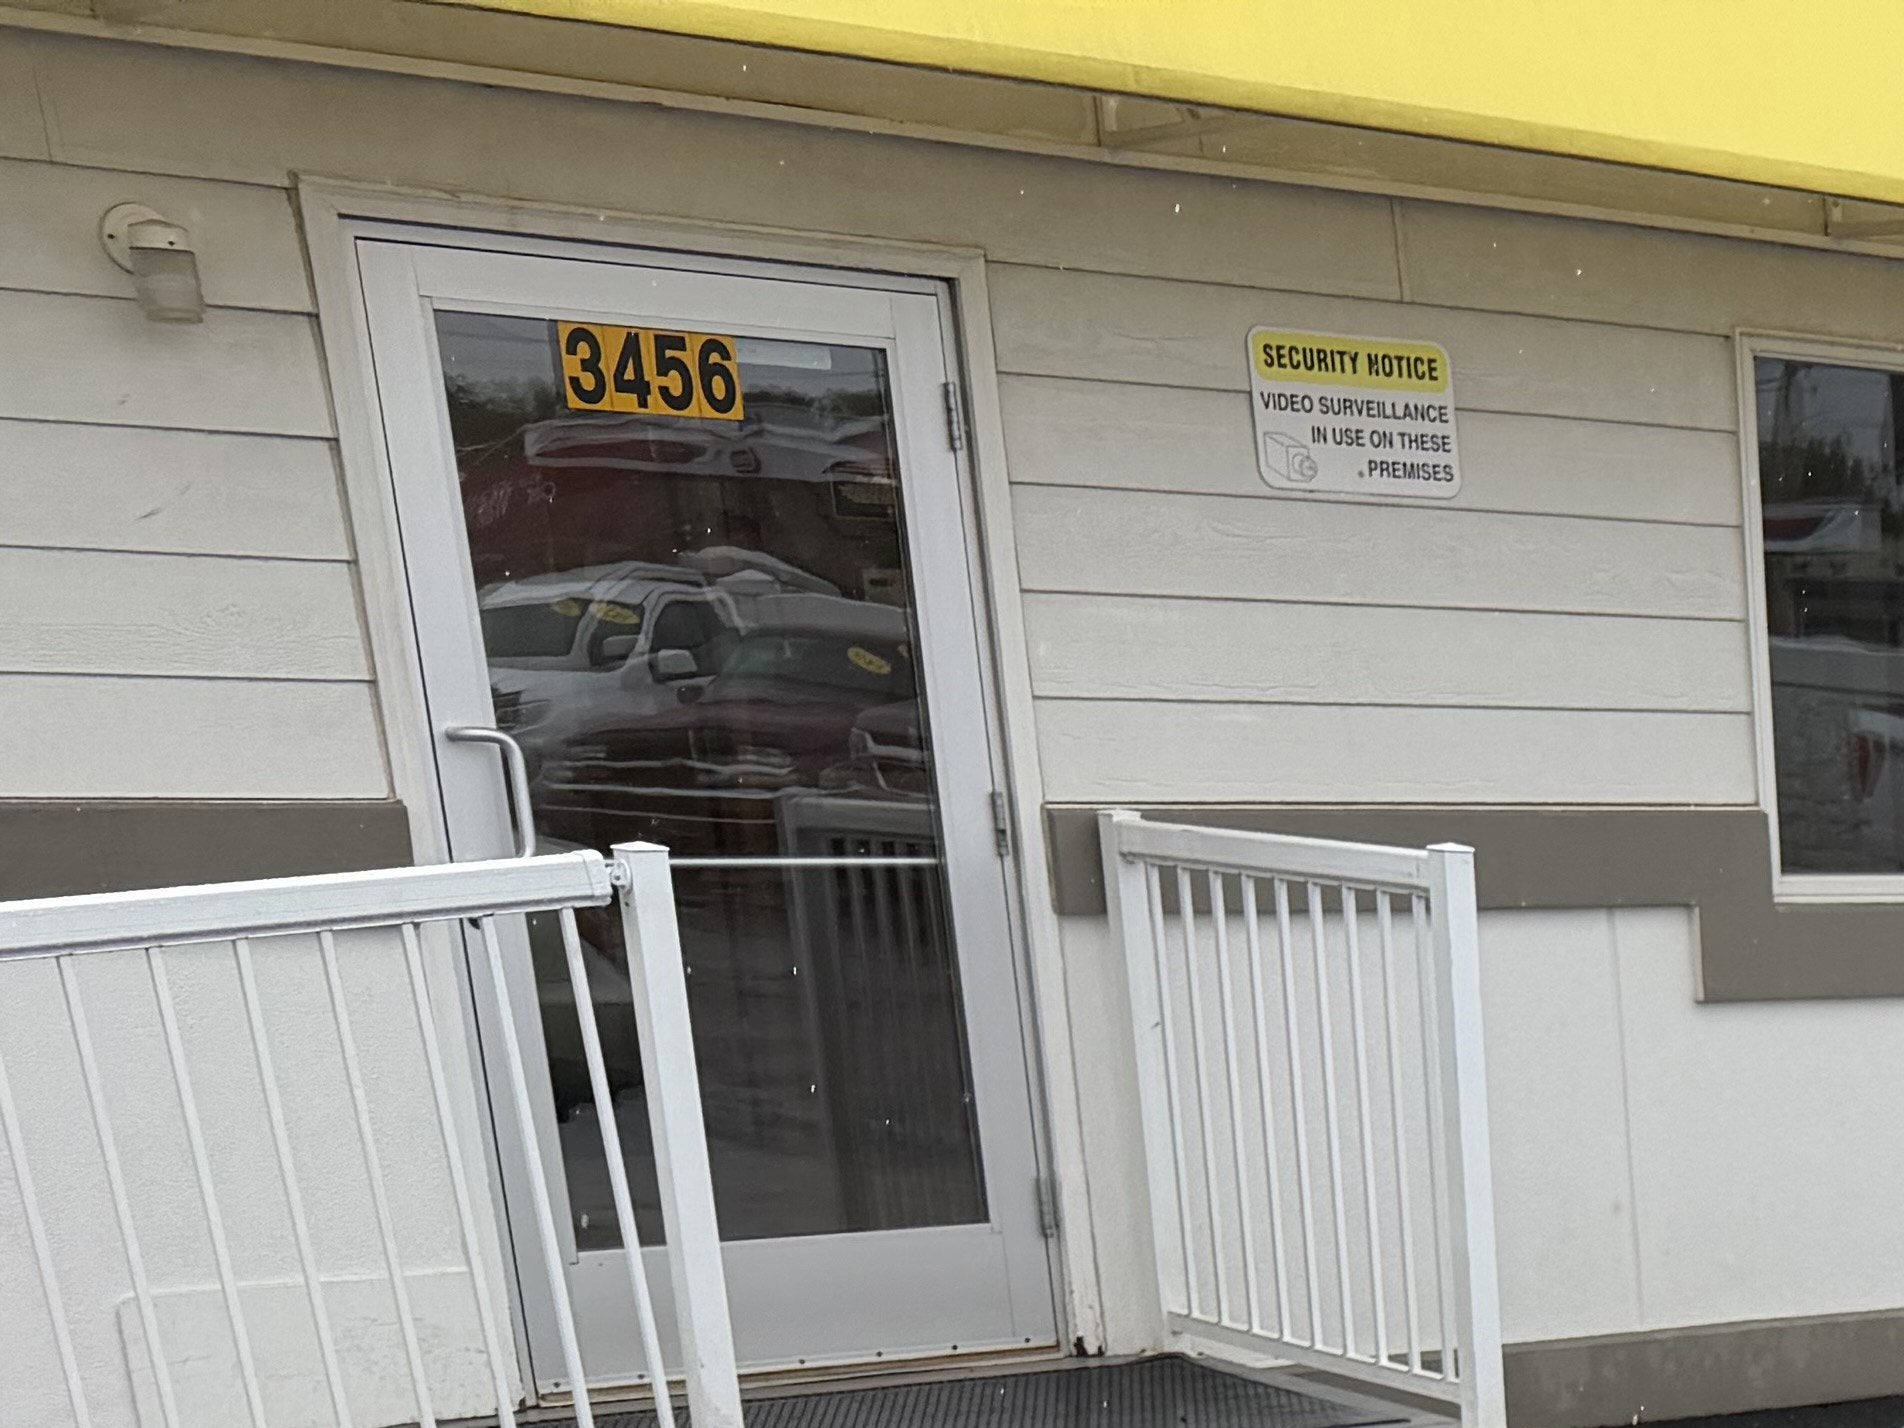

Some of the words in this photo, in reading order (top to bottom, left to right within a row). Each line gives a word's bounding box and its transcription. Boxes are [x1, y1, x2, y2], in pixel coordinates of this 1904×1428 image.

[565, 326, 737, 415] 3456
[1262, 343, 1359, 375] SECURITY
[1367, 353, 1439, 381] NOTICE
[1260, 391, 1314, 413] VIDEO
[1319, 395, 1449, 424] SURVEILLANCE
[1311, 425, 1327, 445] IN
[1332, 428, 1366, 447] USE
[1370, 430, 1394, 449] ON
[1398, 432, 1452, 453] THESE
[1368, 459, 1454, 482] PREMISES
